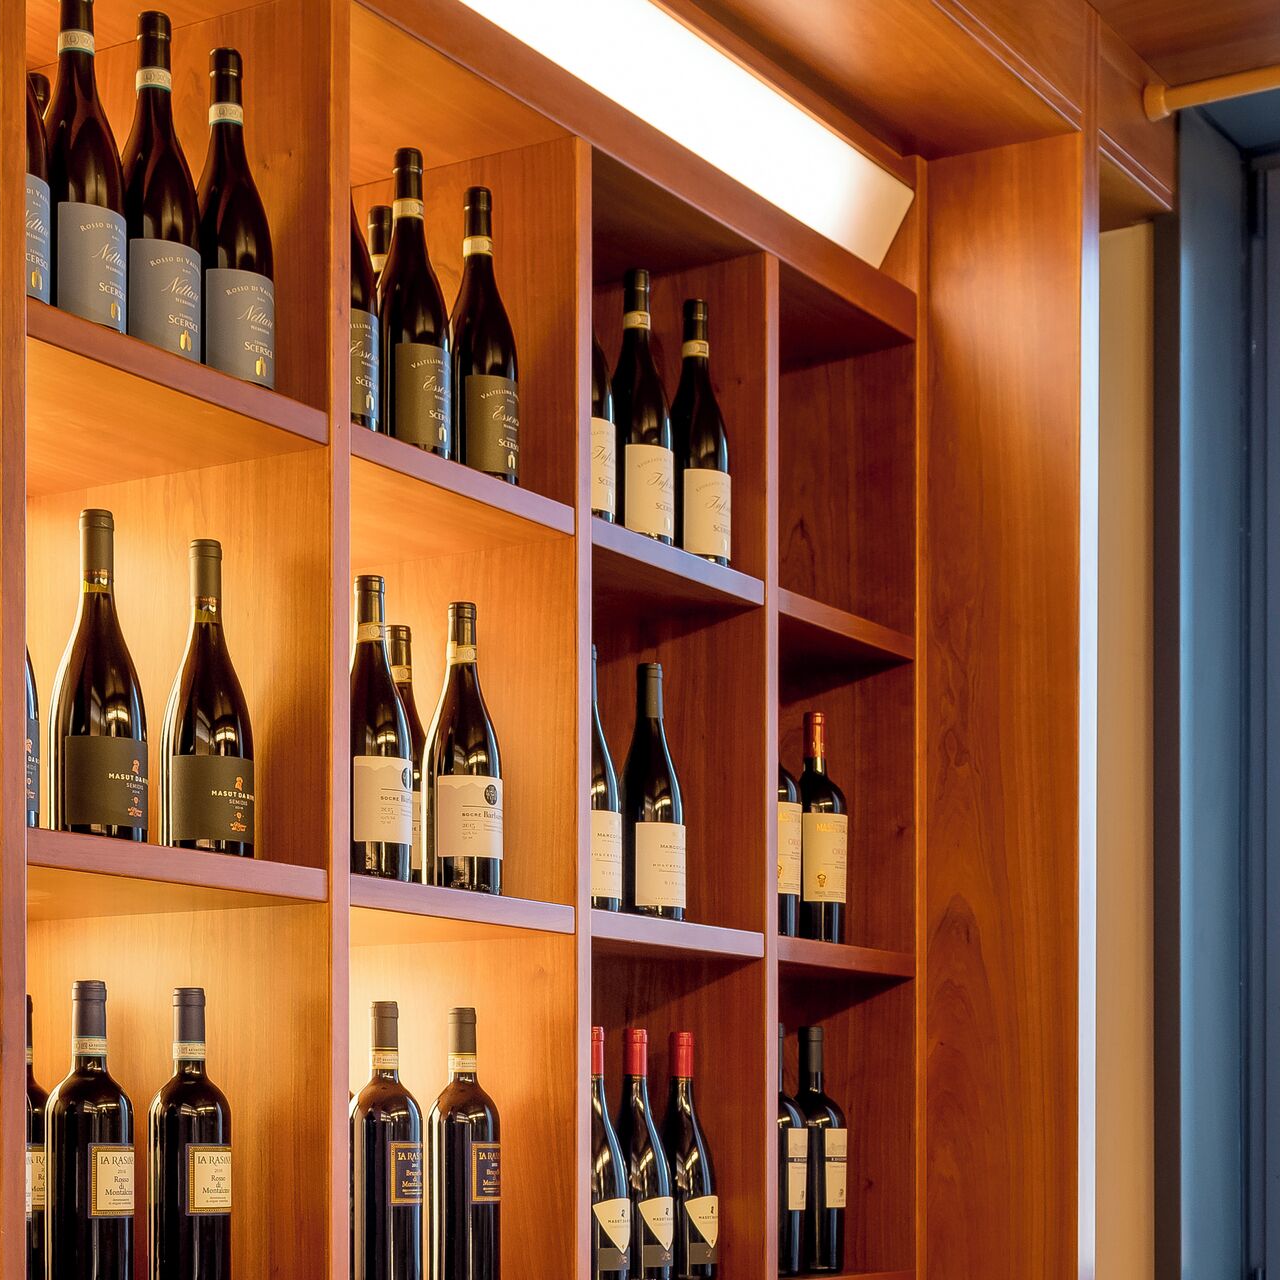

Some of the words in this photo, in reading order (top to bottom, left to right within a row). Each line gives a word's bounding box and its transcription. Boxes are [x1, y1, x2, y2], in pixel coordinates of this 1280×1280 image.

[79, 221, 104, 232] ROSSO
[150, 255, 173, 268] ROSSO
[161, 276, 199, 302] Nettar
[225, 285, 249, 296] ROSSO
[237, 304, 273, 329] Nettar
[168, 314, 199, 333] SCERSC
[244, 341, 273, 359] SCERSC
[410, 359, 444, 369] VALTELLINA
[480, 389, 512, 400] VALTELLINA
[108, 772, 134, 781] MASUT
[100, 1155, 109, 1165] LA
[112, 1155, 134, 1167] RASIN
[197, 1155, 206, 1164] LA
[209, 1155, 231, 1166] RASIN
[397, 1152, 406, 1161] LA
[478, 1151, 487, 1160] LA
[113, 1175, 129, 1183] Rosso
[211, 1174, 226, 1182] Rosso
